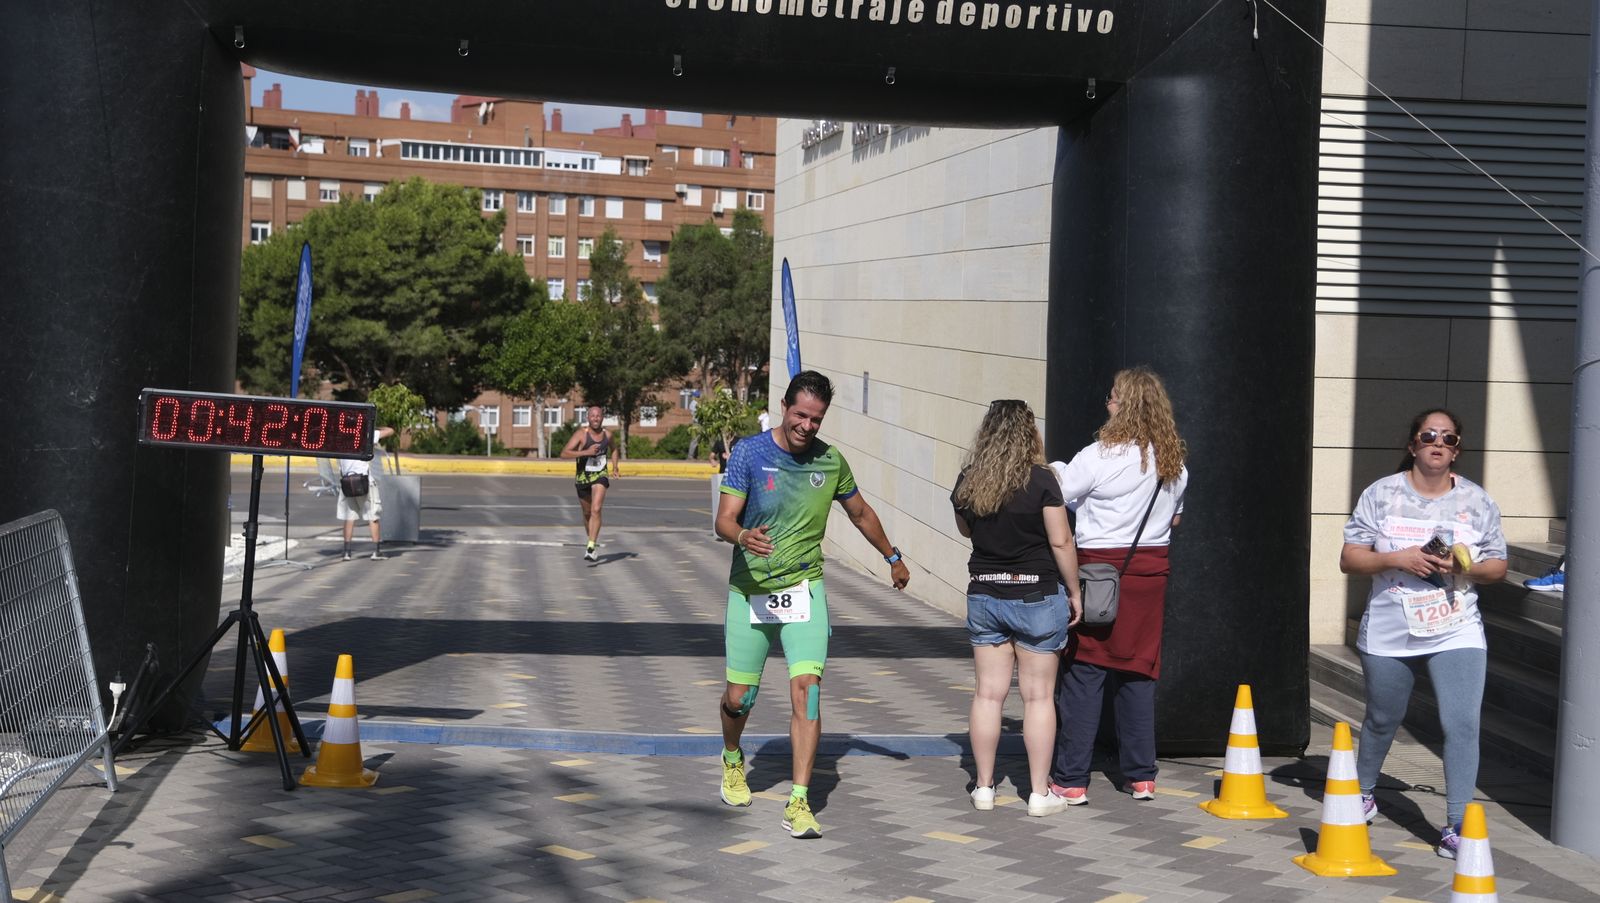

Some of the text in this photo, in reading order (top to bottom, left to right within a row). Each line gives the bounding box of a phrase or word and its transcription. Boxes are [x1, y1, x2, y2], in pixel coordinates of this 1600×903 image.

[935, 0, 1115, 35] deportivo
[768, 593, 793, 609] 38
[1414, 599, 1460, 623] 1202
